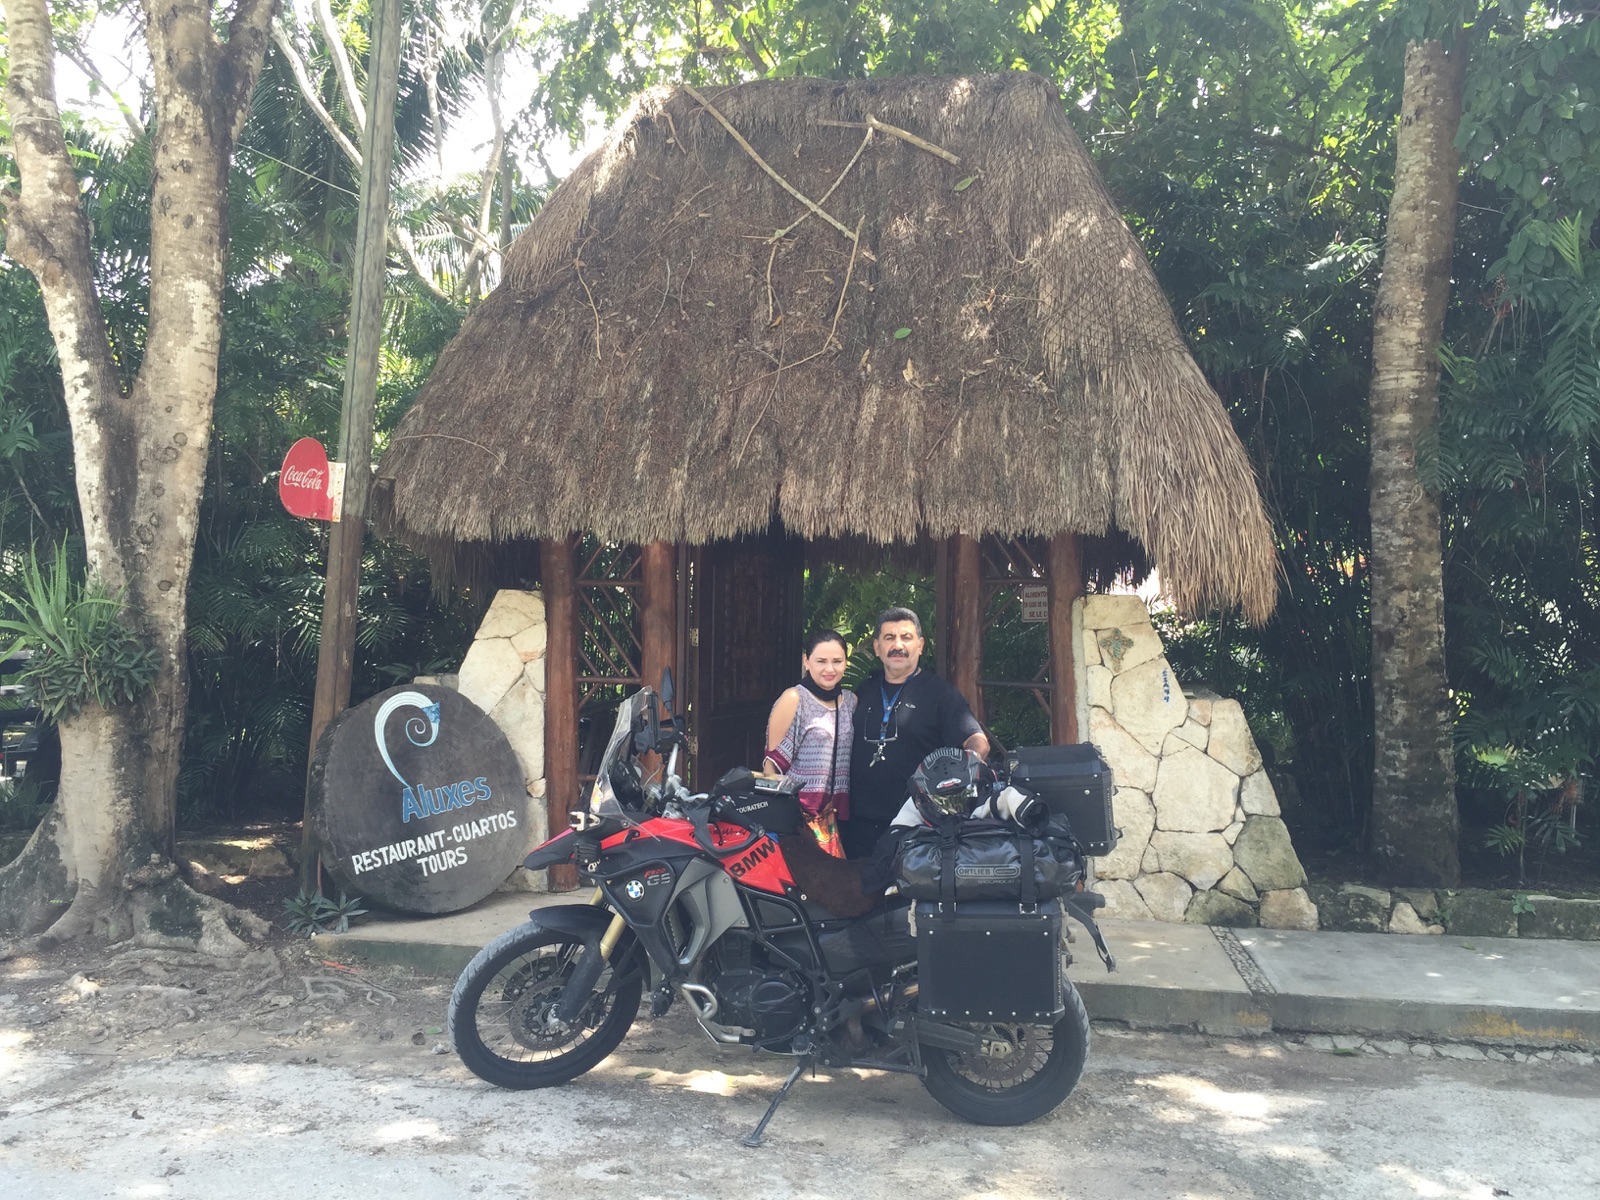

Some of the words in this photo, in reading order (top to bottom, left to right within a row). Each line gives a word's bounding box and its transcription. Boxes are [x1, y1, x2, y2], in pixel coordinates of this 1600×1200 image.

[403, 776, 492, 824] Aluxes
[416, 846, 468, 877] TOURS
[729, 837, 776, 879] BMW
[647, 873, 671, 886] GS
